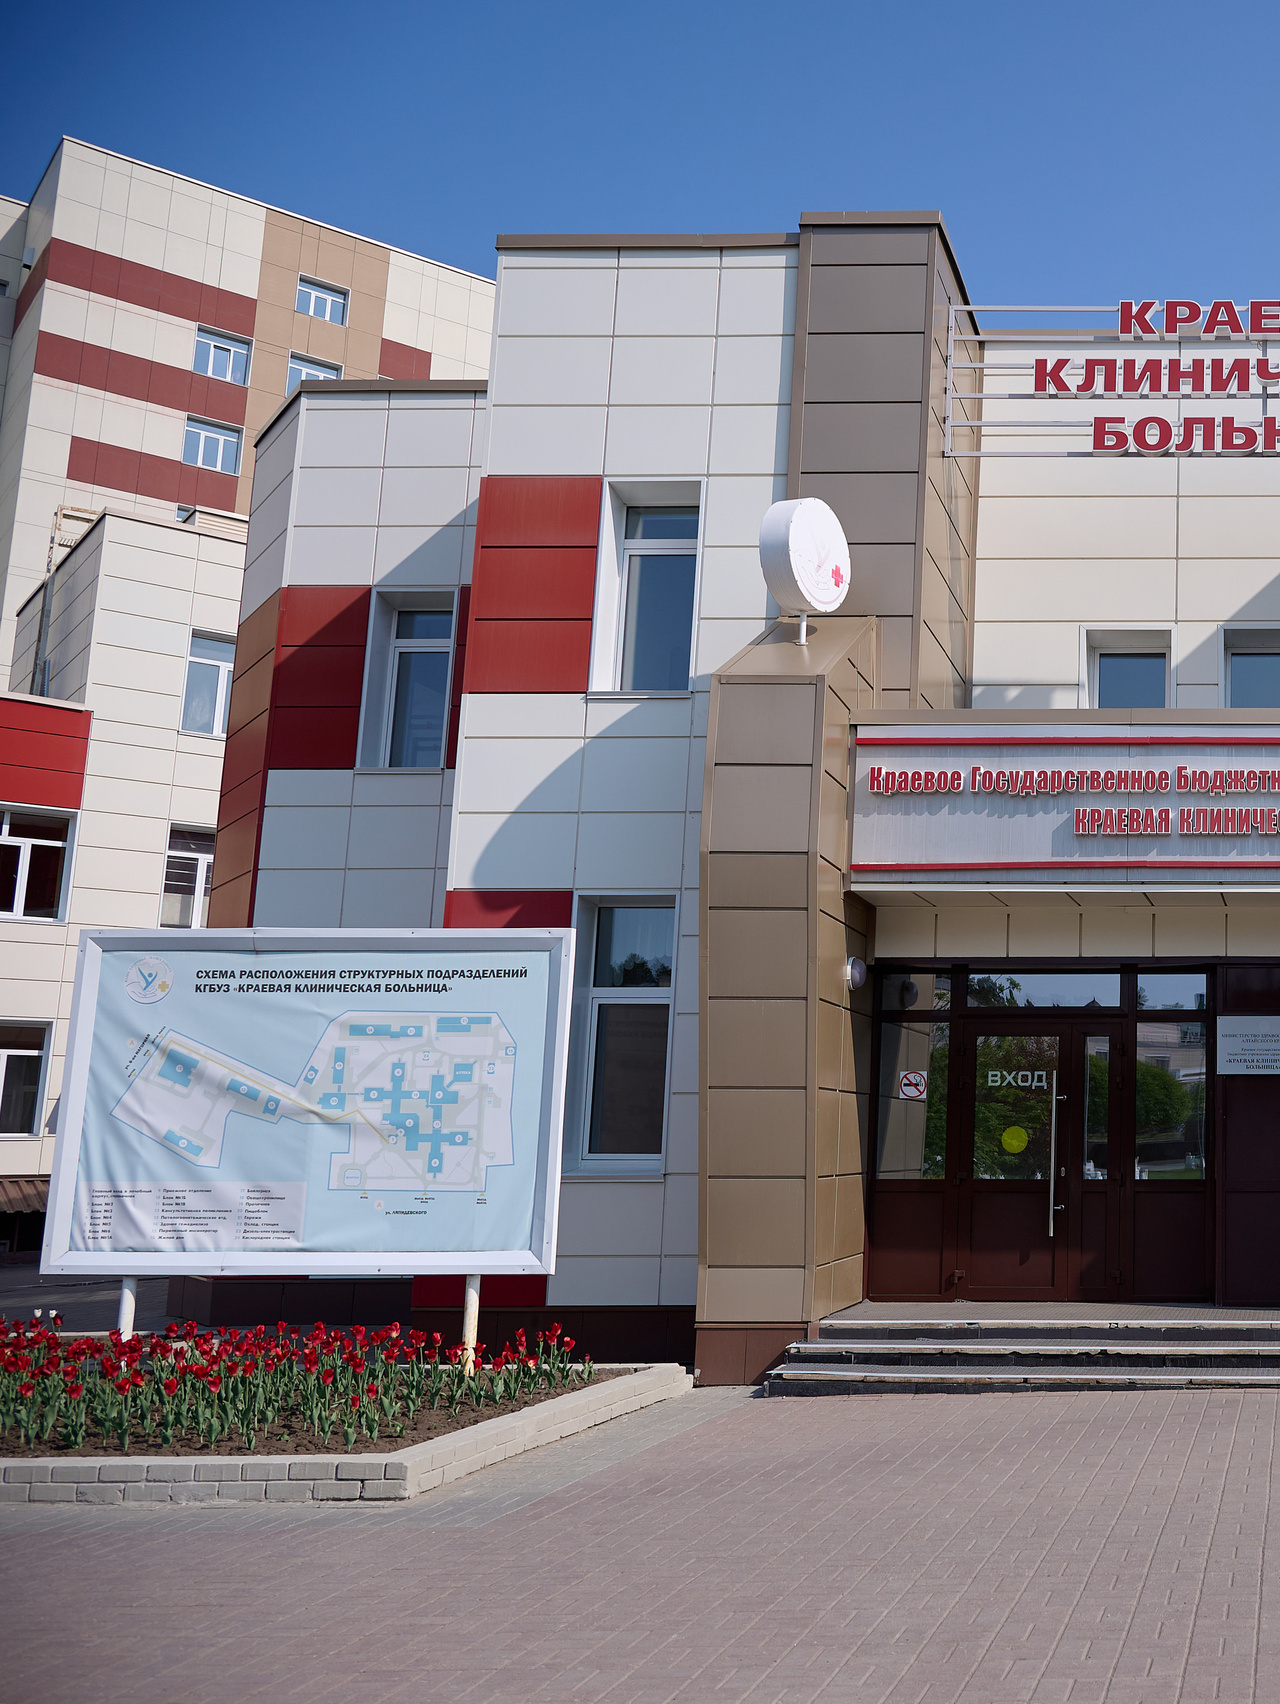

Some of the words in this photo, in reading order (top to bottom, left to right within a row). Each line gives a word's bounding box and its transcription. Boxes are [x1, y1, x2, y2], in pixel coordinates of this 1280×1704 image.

[868, 766, 963, 795] Краевое
[969, 766, 1170, 797] Государственное
[1073, 807, 1171, 836] КРАЕВАЯ
[196, 970, 236, 979] СХЕМА
[239, 970, 336, 979] РАСПОЛОЖЕНИЯ
[338, 969, 424, 979] СТРУКТУРНЫХ
[426, 966, 528, 980] ПОДРАЗДЕЛЕНИЙ
[194, 984, 230, 993] КГБУЗ
[233, 984, 292, 993] «КРАЕВАЯ
[294, 984, 382, 993] КЛИНИЧЕСКАЯ
[384, 984, 452, 994] БОЛЬНИЦА»
[988, 1071, 1048, 1090] ВХОД
